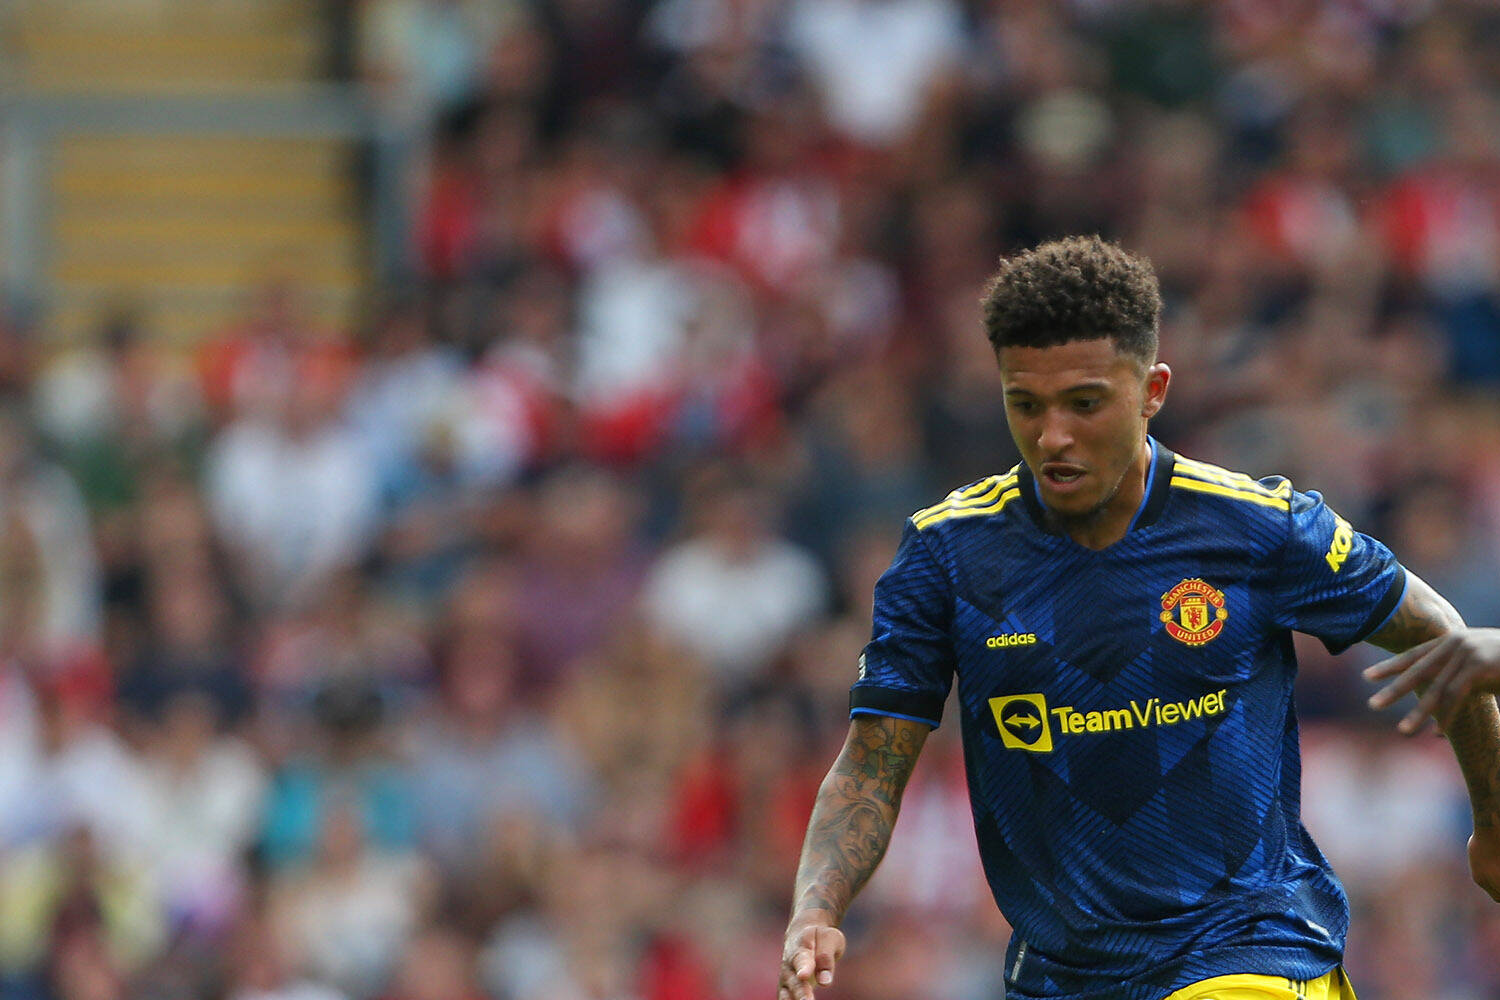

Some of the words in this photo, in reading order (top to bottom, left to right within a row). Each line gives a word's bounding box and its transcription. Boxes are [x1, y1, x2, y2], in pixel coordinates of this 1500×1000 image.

[1165, 582, 1221, 606] MANCHESTER
[986, 632, 1037, 648] adidas
[1176, 629, 1215, 641] UNITED
[1051, 689, 1227, 734] TeamViewer
